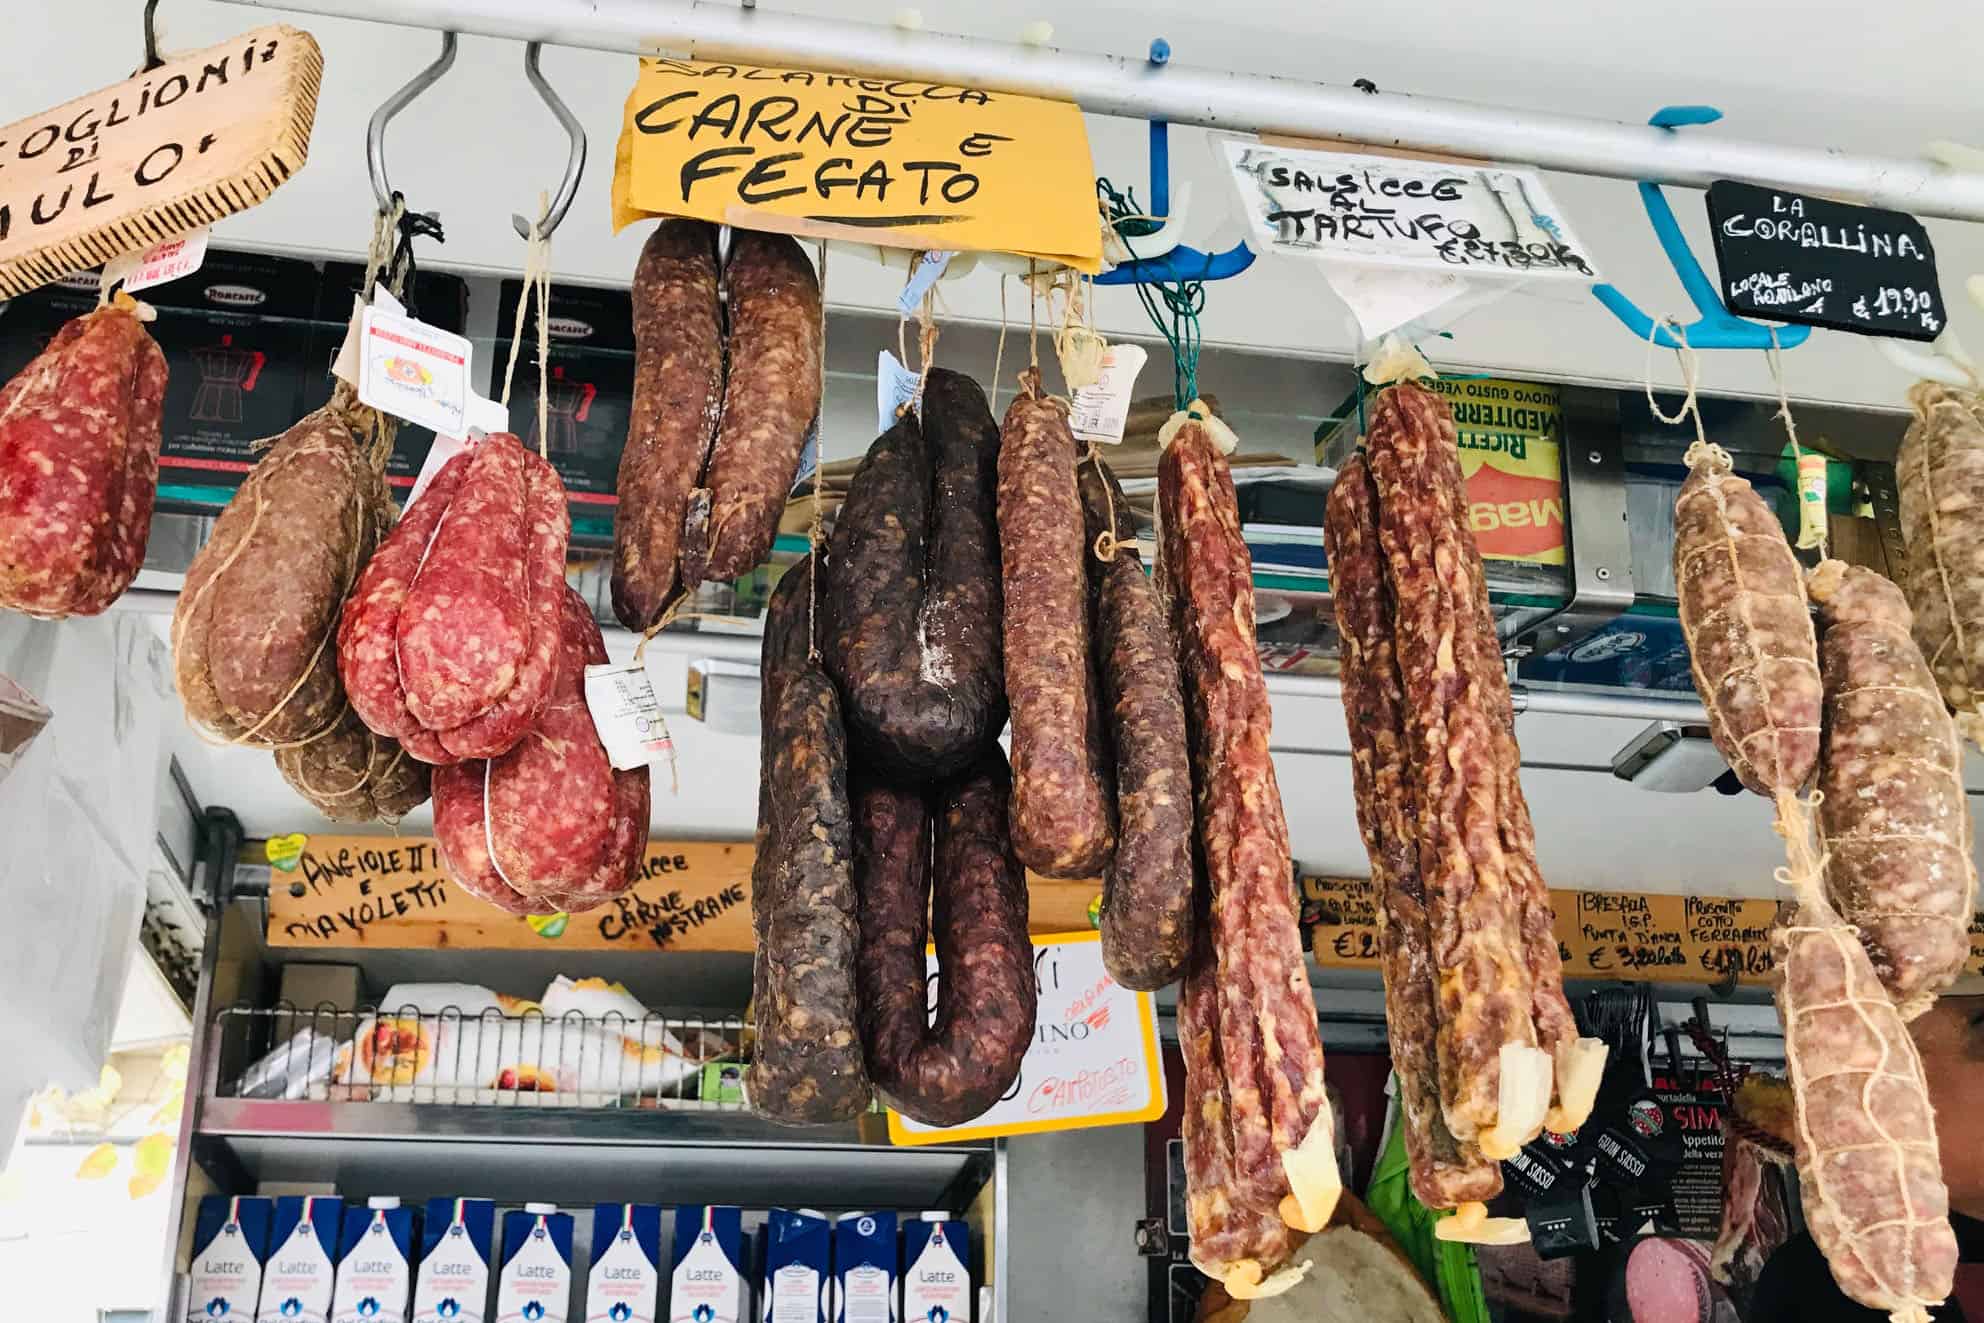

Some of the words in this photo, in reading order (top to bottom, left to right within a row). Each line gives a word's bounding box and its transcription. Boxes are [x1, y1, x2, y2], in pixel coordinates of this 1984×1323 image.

[0, 39, 257, 168] OGLIONI
[635, 91, 911, 148] CARNE
[958, 133, 1016, 157] E
[680, 147, 980, 205] FEGATO
[1331, 192, 1396, 214] AL
[1773, 196, 1805, 218] LA
[1266, 209, 1482, 241] TARTUFO
[1723, 214, 1925, 261] CORALLINA
[1731, 272, 1790, 297] LOCALE
[1466, 384, 1510, 401] GUSTO
[1448, 401, 1563, 437] MEDITERR
[205, 1261, 245, 1274] Latte
[278, 1261, 317, 1275] Latte
[353, 1260, 393, 1273] Latte
[432, 1262, 473, 1276] Latte
[516, 1264, 556, 1278] Latte
[604, 1266, 641, 1280] Latte
[686, 1268, 723, 1281] Latte
[919, 1269, 955, 1283] Latte
